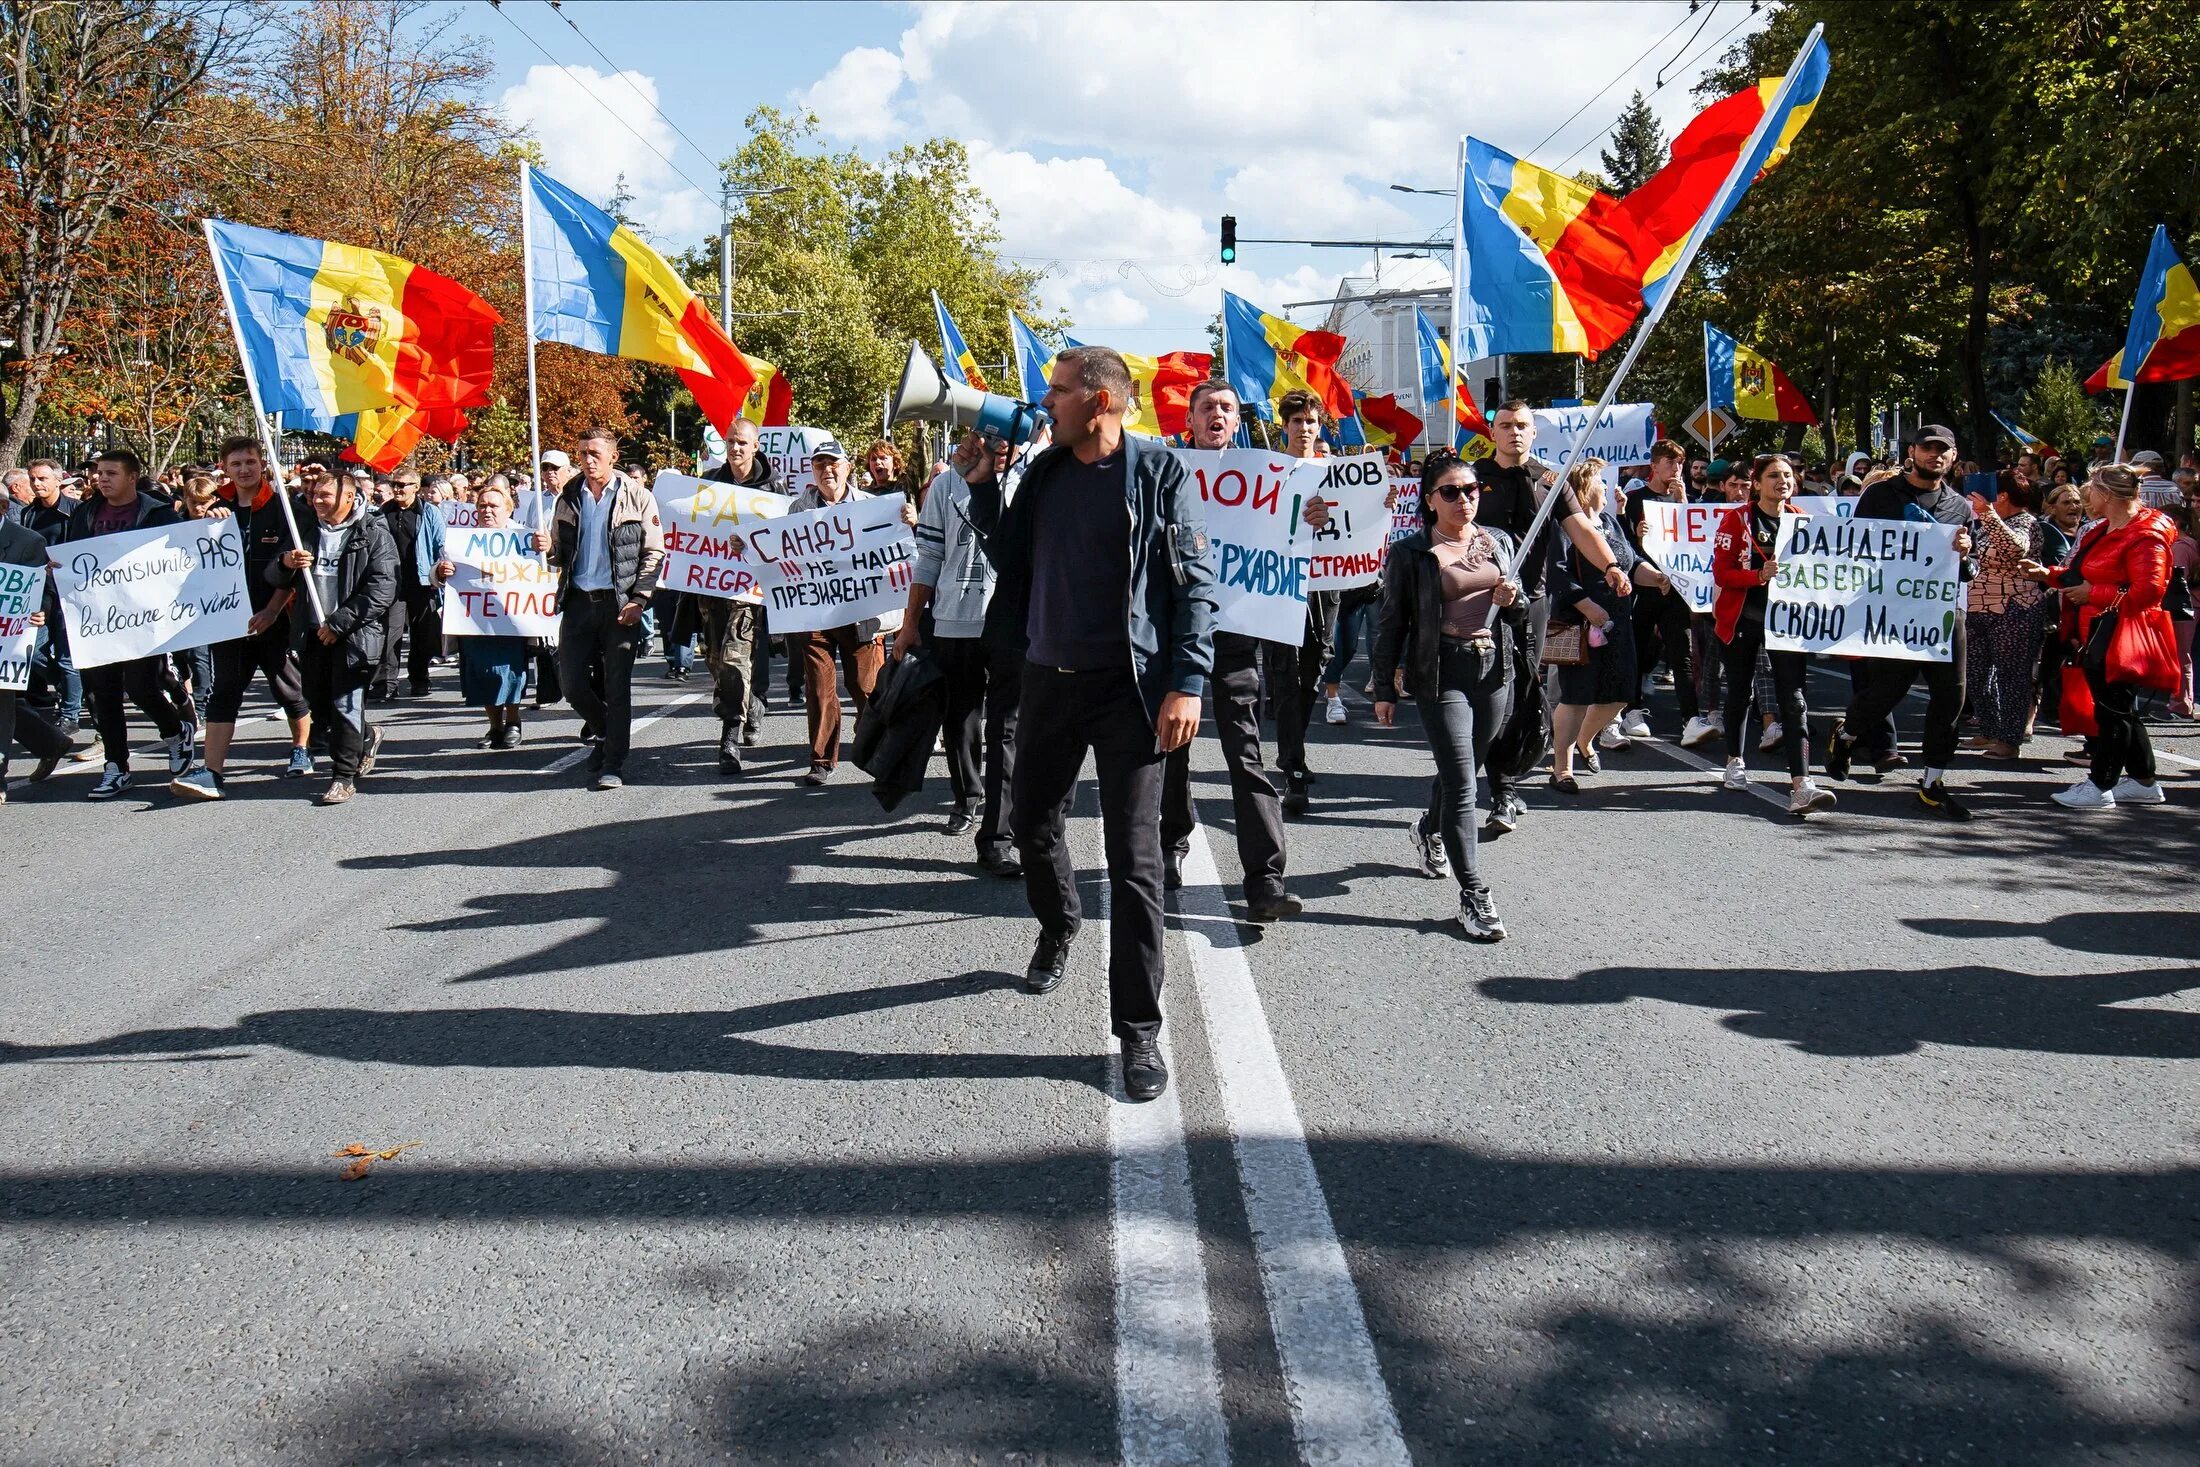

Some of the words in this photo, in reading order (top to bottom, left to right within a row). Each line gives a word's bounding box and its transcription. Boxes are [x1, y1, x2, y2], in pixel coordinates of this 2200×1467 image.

[691, 484, 774, 527] PAS
[196, 533, 244, 571] PAS,
[664, 522, 749, 564] dEZAMA
[750, 516, 855, 563] САНДУ
[1791, 517, 1933, 566] БАЙДЕН,
[806, 560, 838, 579] НЕ
[1776, 562, 1884, 595] ЗАБЕРИ
[1896, 578, 1956, 602] СЕБЕ
[459, 591, 557, 617] ТЕПЛО
[771, 575, 883, 610] ПРЕЗИДЕНТ
[1770, 600, 1845, 641] СВОЮ
